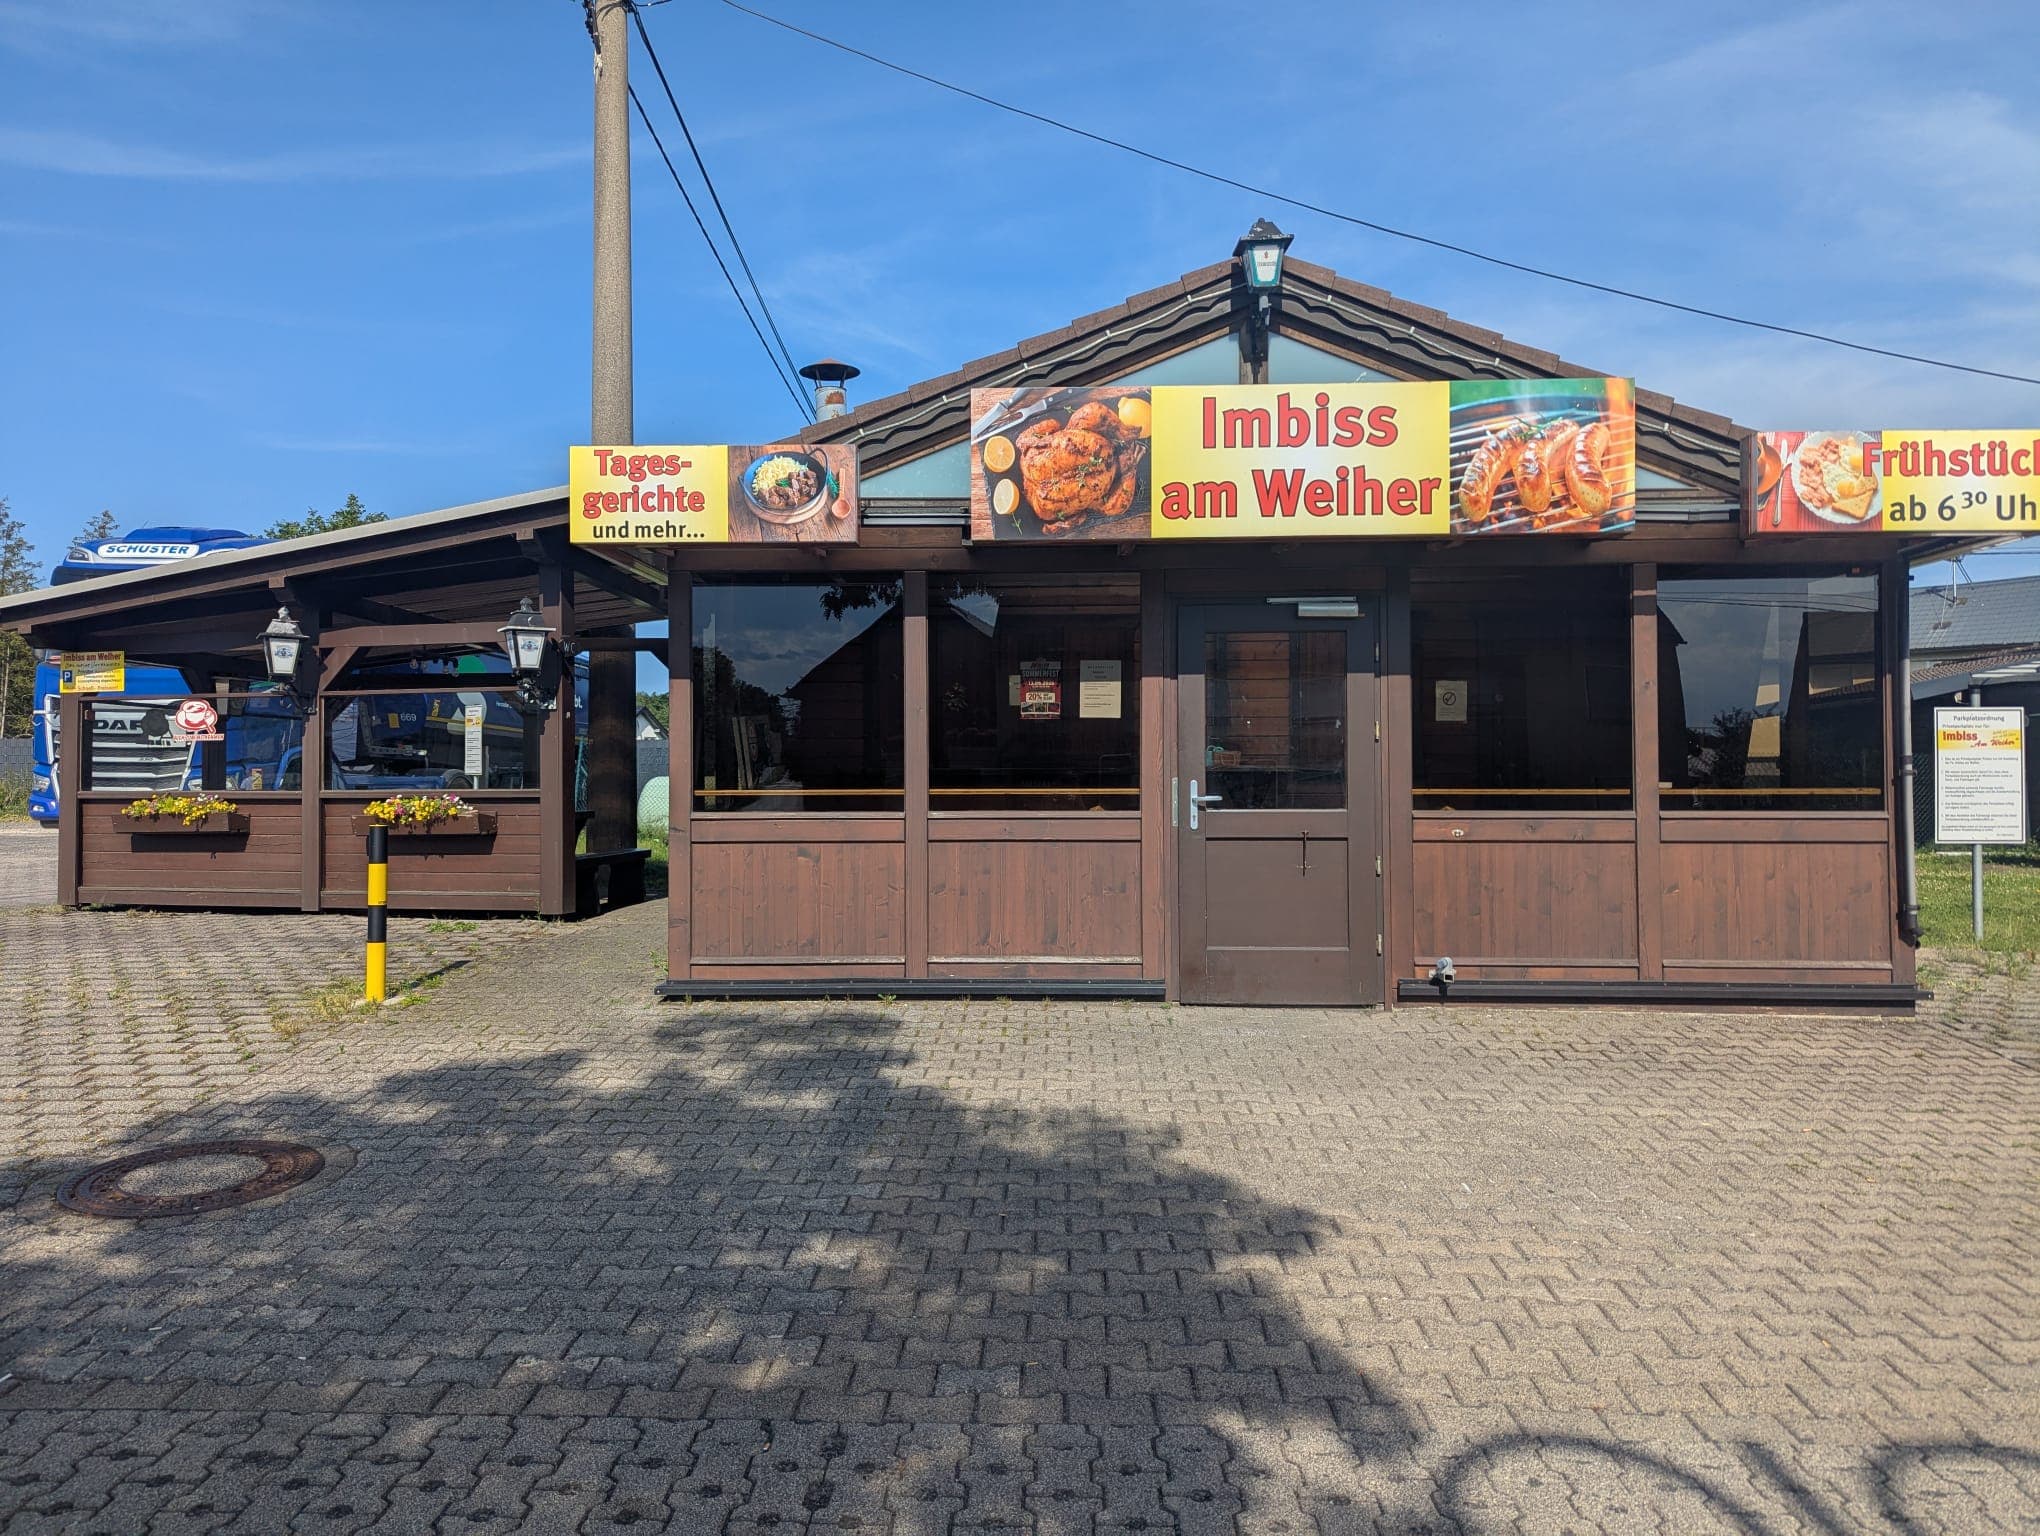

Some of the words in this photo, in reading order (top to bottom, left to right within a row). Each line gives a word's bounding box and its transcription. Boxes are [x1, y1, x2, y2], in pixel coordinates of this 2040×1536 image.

[1201, 391, 1399, 448] Imbiss
[594, 449, 692, 482] Tages-
[582, 484, 706, 519] gerichte
[1160, 478, 1237, 520] am
[1250, 464, 1443, 518] Weiher
[1889, 494, 1927, 522] ab
[592, 520, 629, 539] und
[635, 520, 705, 539] mehr...
[106, 544, 190, 554] SCHUSTER
[63, 653, 85, 661] Imbiss
[95, 719, 143, 731] DAF
[400, 713, 417, 722] 669
[1942, 730, 1978, 741] Imbiss
